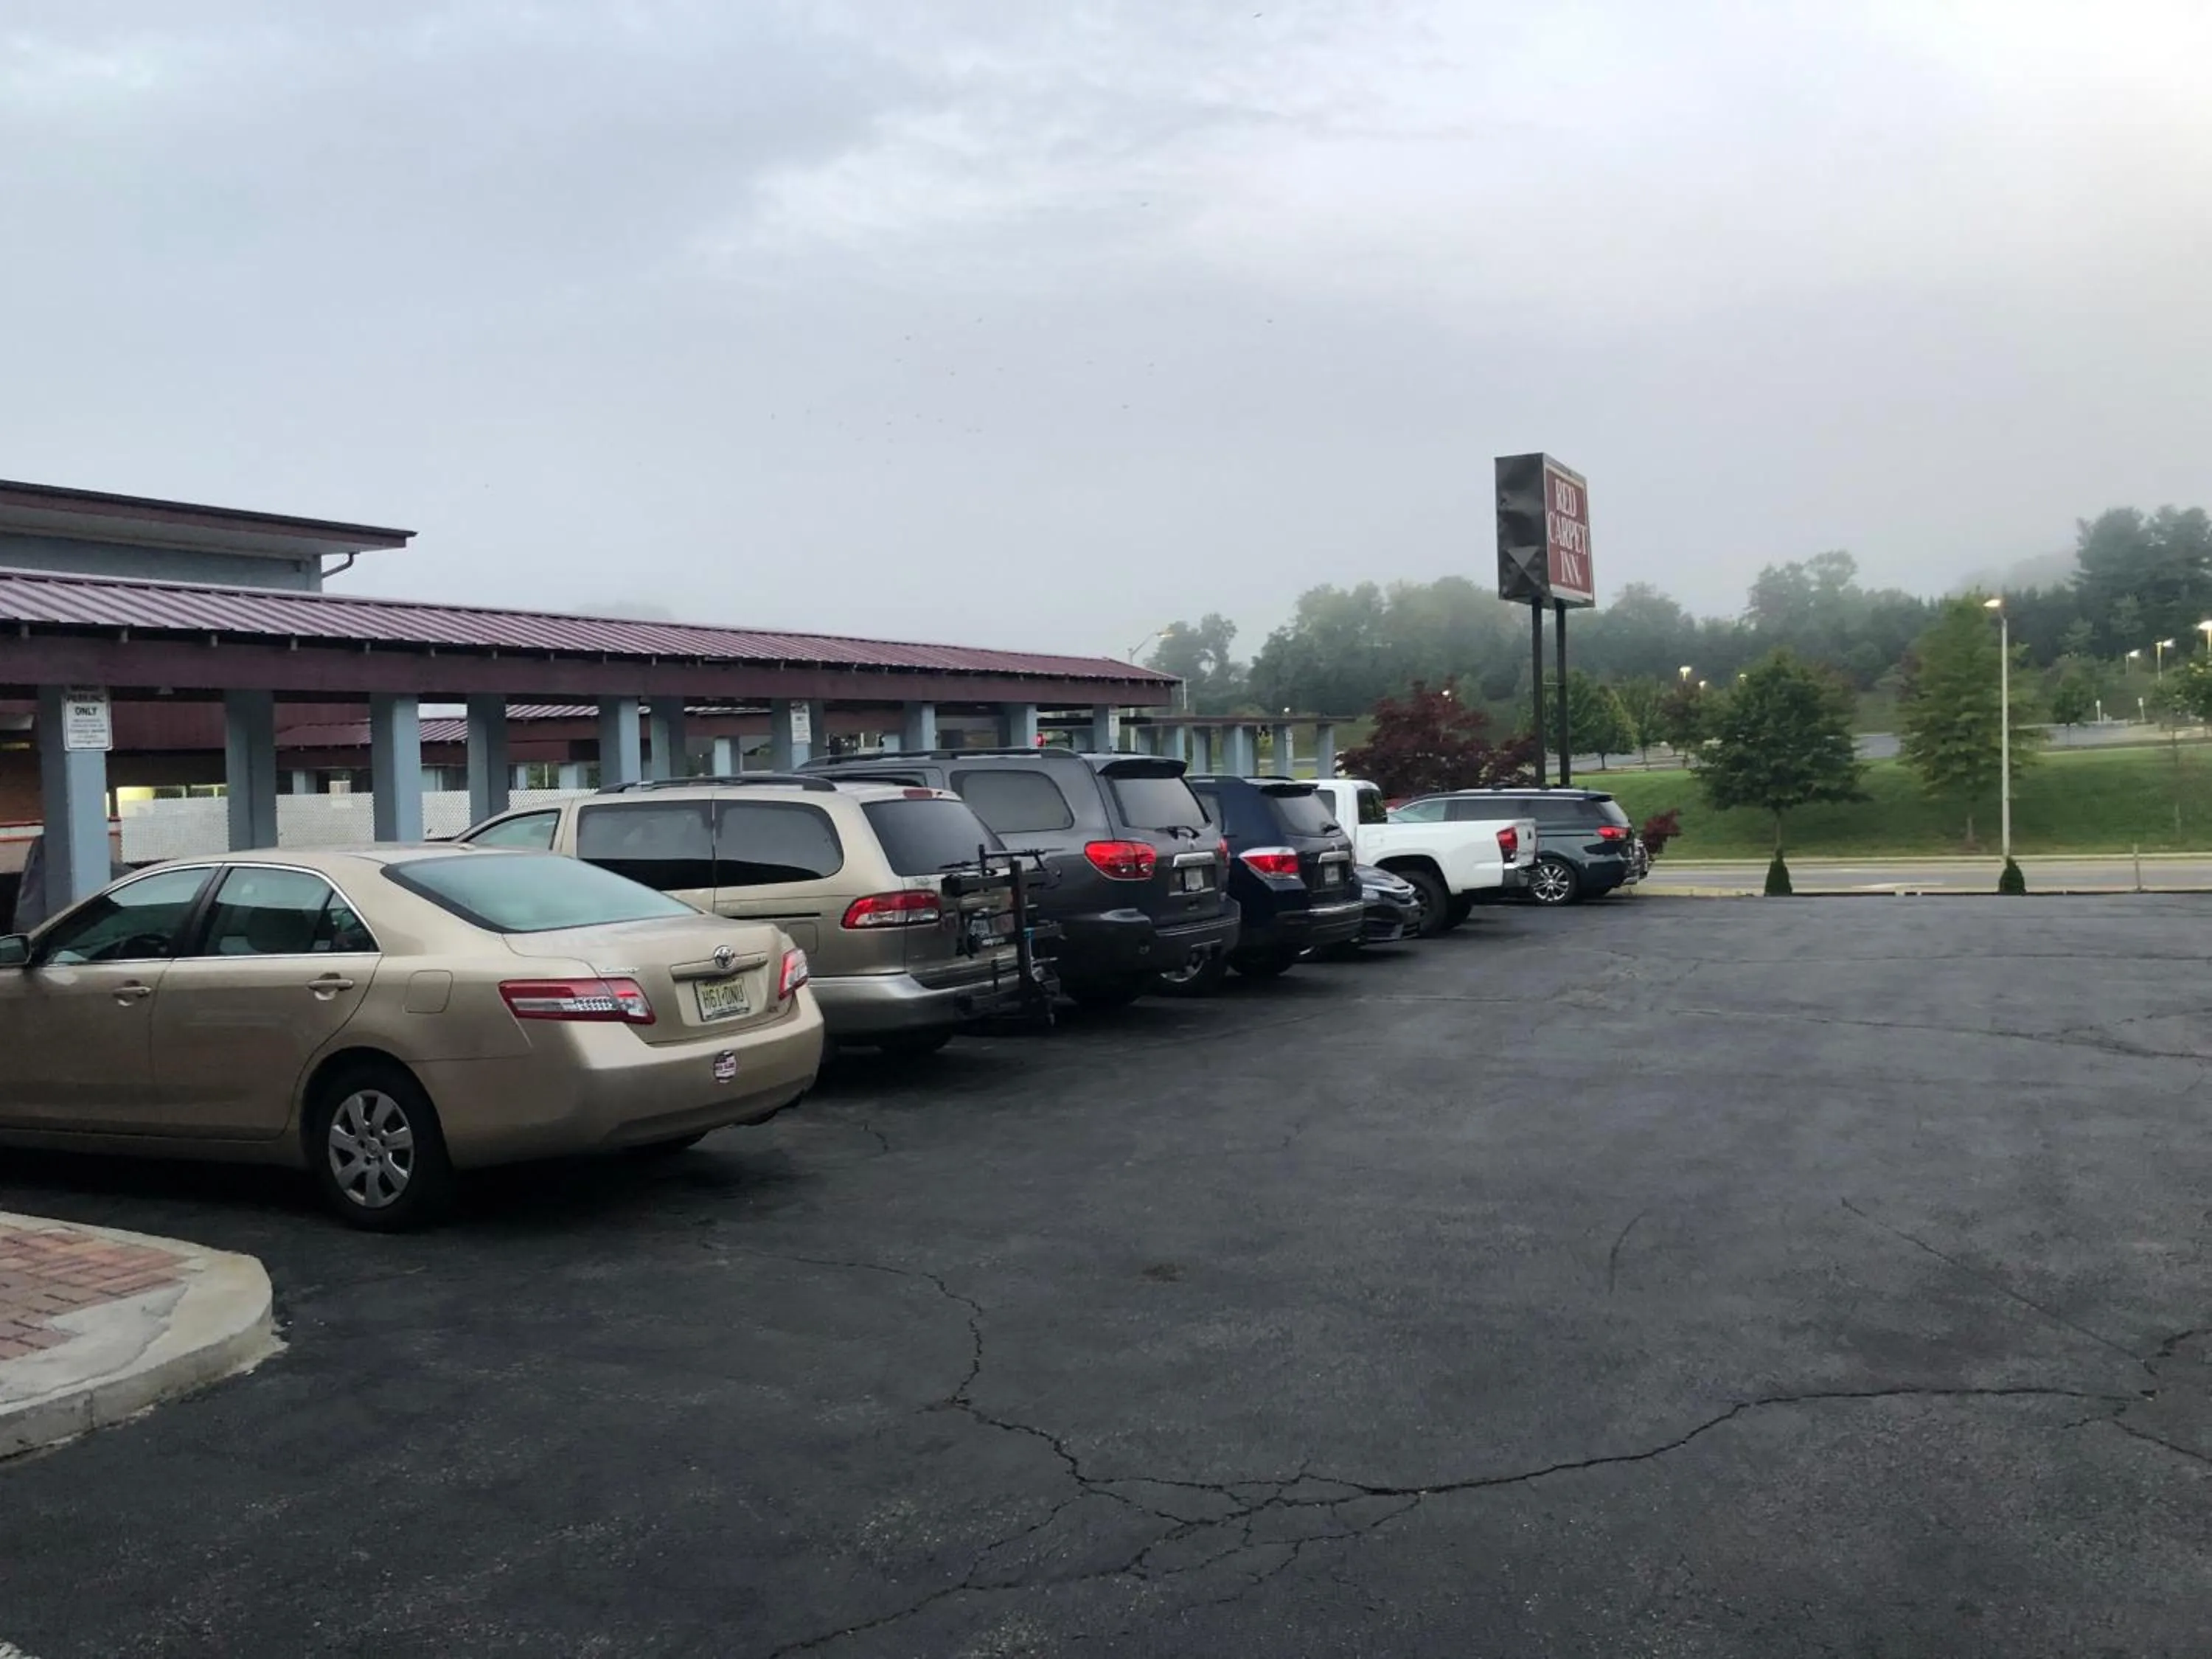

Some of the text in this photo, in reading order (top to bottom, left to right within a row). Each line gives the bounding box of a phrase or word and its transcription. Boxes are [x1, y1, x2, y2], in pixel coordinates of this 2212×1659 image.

[1554, 478, 1577, 517] RED
[1548, 511, 1587, 555] CARPET
[1559, 550, 1582, 586] INN
[74, 706, 97, 716] ONLY
